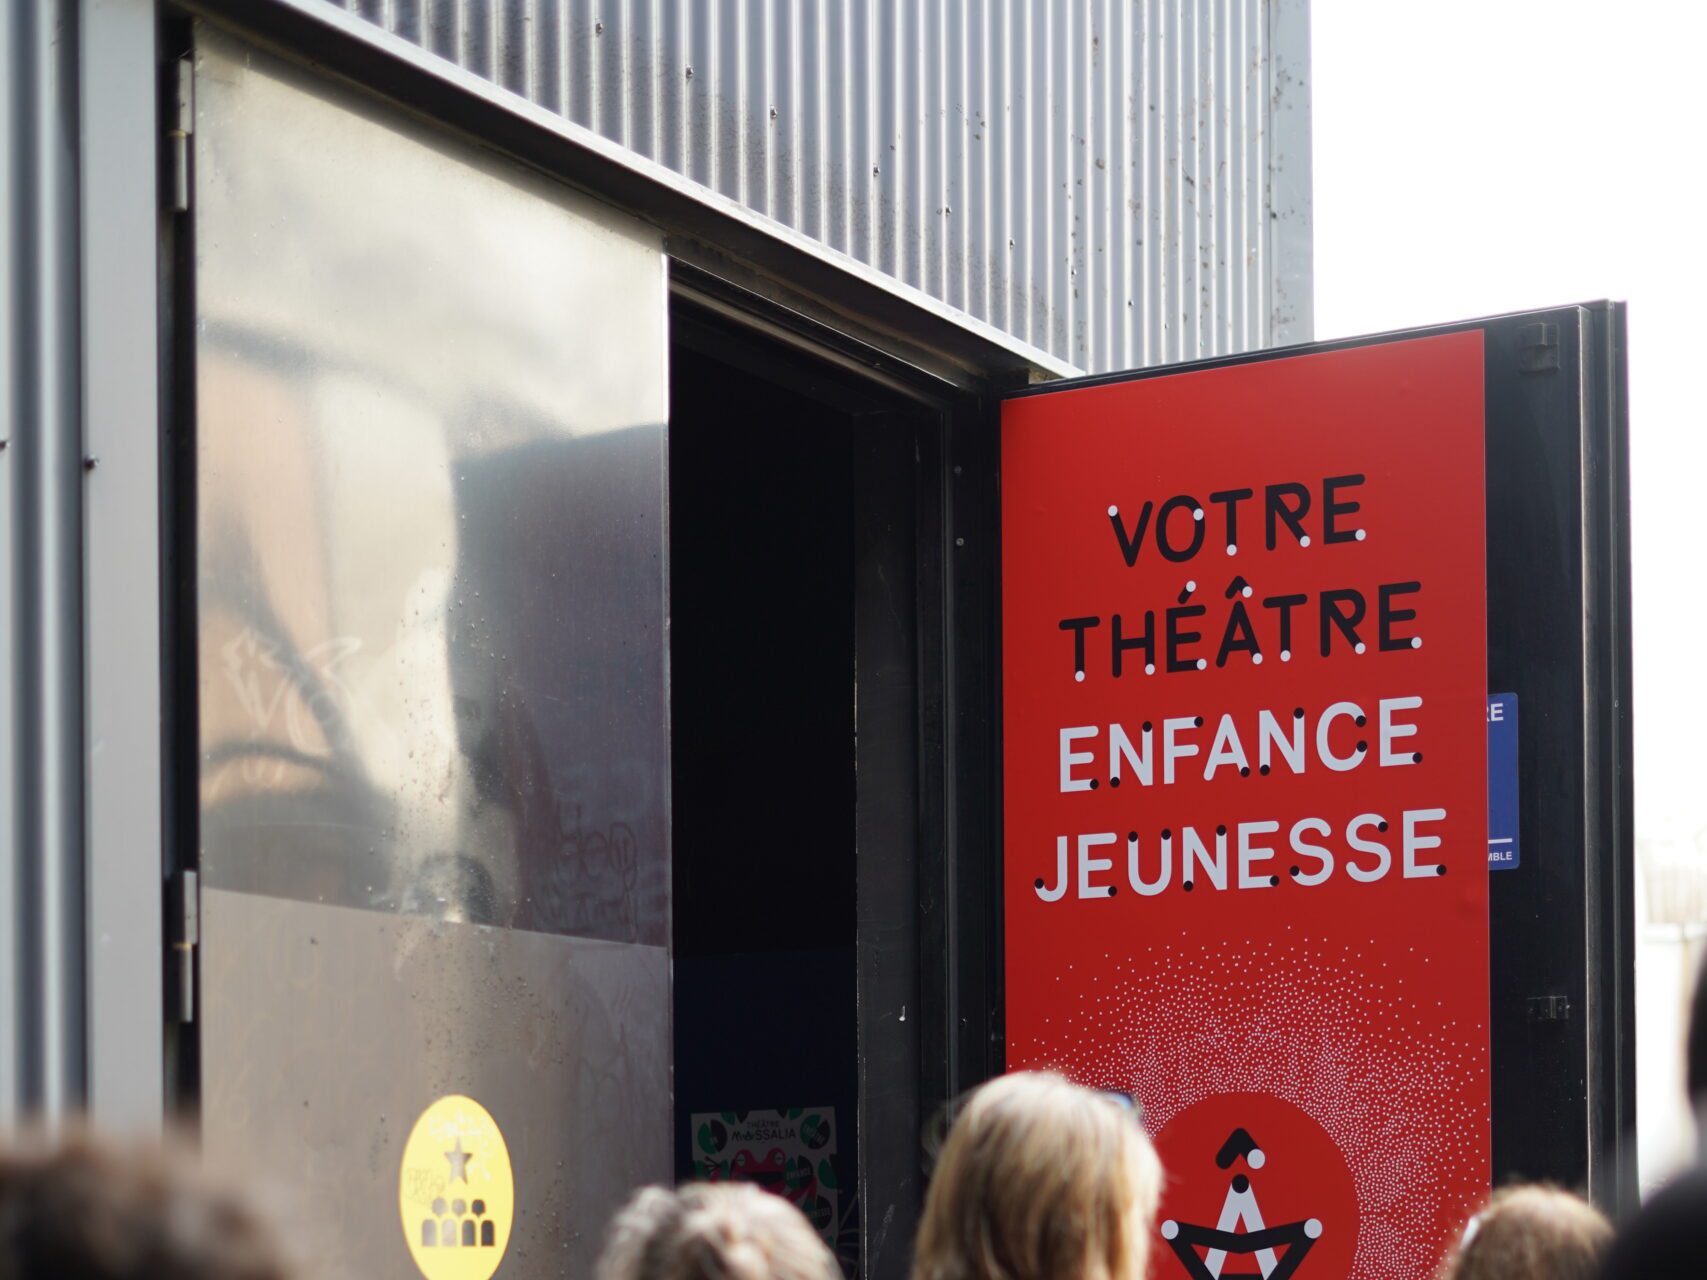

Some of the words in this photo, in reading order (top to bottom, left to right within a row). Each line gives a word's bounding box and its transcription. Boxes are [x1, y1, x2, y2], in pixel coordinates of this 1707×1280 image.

[1107, 473, 1366, 568] VOTRE
[1058, 575, 1423, 683] THÉÂTRE
[1059, 695, 1424, 794] ENFANCE
[1034, 807, 1448, 903] JEUNESSE
